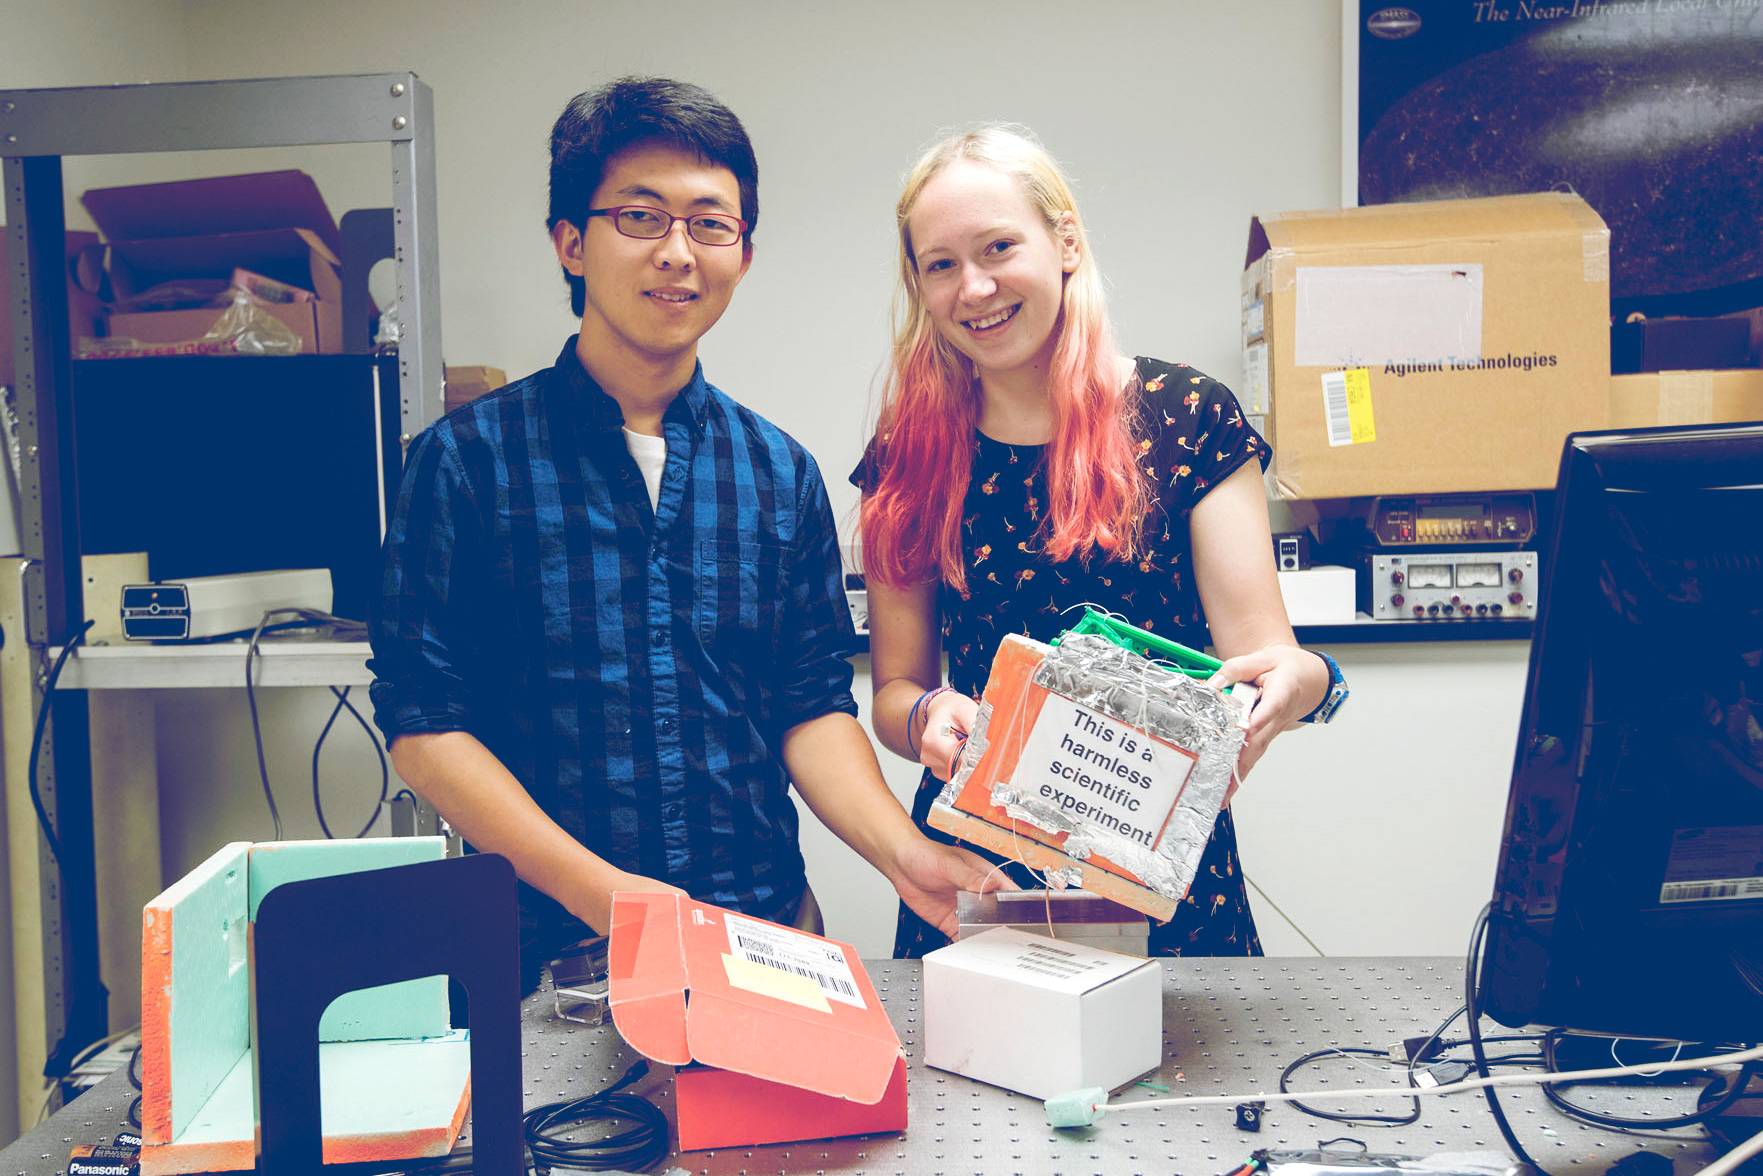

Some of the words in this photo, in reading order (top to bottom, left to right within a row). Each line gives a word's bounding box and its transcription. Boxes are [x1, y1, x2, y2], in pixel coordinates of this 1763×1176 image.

[1473, 0, 1509, 22] The
[1515, 0, 1648, 20] Near-Infrared
[1384, 358, 1444, 377] Agilent
[1448, 352, 1558, 373] Technologies
[1074, 709, 1114, 742] This
[1119, 732, 1137, 753] is
[1141, 748, 1153, 762] a
[1060, 733, 1152, 789] harmless
[1050, 760, 1141, 812] scientific
[1039, 783, 1153, 846] experiment
[119, 1135, 143, 1146] sonic
[69, 1163, 130, 1176] Panasonic
